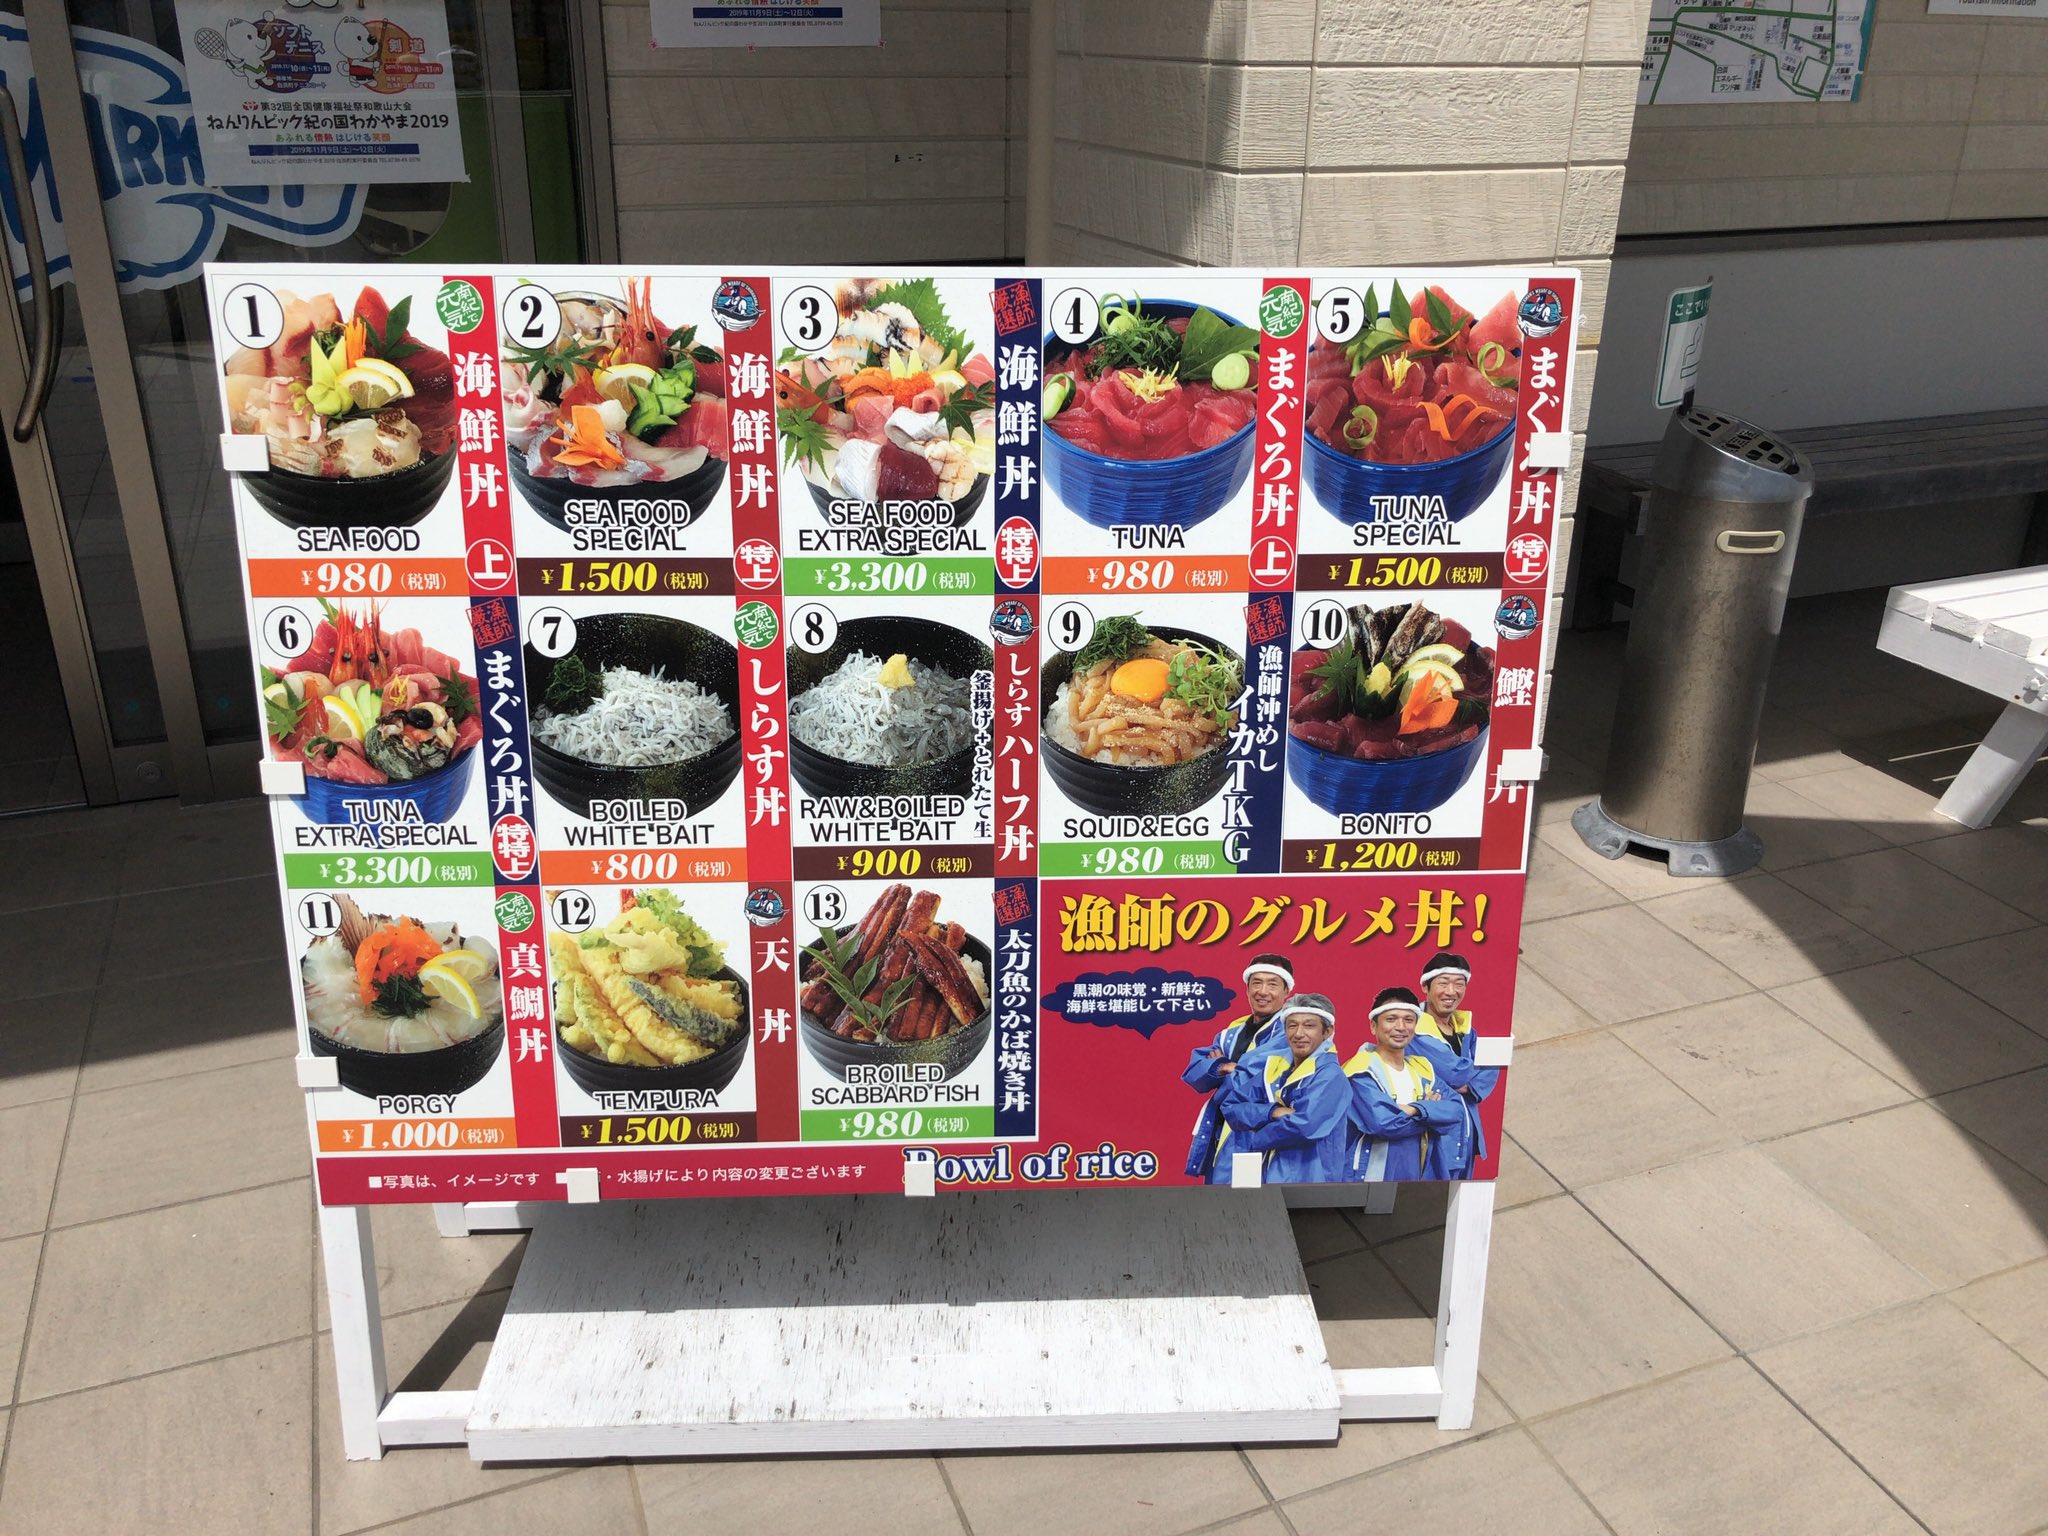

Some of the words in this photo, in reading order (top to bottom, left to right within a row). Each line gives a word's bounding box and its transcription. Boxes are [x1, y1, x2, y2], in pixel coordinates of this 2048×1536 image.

[272, 24, 313, 37] ソフト
[285, 38, 326, 55] テニス
[261, 101, 412, 112] 第32回全国健康福祉祭和歌山大会
[207, 114, 449, 130] ねんりんピック紀の国わかやま2019
[242, 295, 265, 338] 1
[520, 296, 545, 338] 2
[799, 297, 822, 340] 3
[1065, 297, 1084, 335] 4
[1329, 297, 1352, 334] 5
[453, 352, 504, 508] 海鮮丼
[729, 353, 774, 509] 海鮮丼
[998, 345, 1038, 500] 海鮮丼
[1256, 348, 1299, 528] まぐろ丼
[565, 503, 618, 525] SEA
[622, 503, 690, 525] FOOD
[831, 503, 881, 526] SEA
[886, 503, 954, 525] FOOD
[1371, 498, 1446, 521] TUNA
[297, 529, 348, 552] SEA
[353, 529, 420, 551] FOOD
[573, 529, 686, 551] SPECIAL
[799, 529, 882, 551] EXTRA
[888, 529, 987, 551] SPECIAL
[1112, 527, 1185, 549] TUNA
[1353, 524, 1461, 546] SPECIAL
[473, 544, 508, 580] 上
[739, 545, 774, 583] 特上
[1000, 526, 1034, 583] 特特上
[1255, 542, 1287, 577] 上
[1511, 539, 1546, 576] 特上
[301, 563, 392, 592] ¥980
[401, 572, 446, 590] (税別)
[541, 562, 658, 592] ¥1,500
[663, 572, 709, 590] (税別)
[815, 562, 927, 592] ¥3,300
[932, 571, 976, 590] (税別)
[1087, 560, 1174, 590] ¥980
[1185, 568, 1229, 587] (税別)
[1328, 557, 1441, 587] ¥1,500
[1445, 565, 1489, 584] (税別)
[278, 615, 299, 650] 6
[542, 616, 562, 650] 7
[805, 612, 824, 646] 8
[1062, 610, 1081, 644] 9
[1309, 608, 1342, 641] 10
[1256, 645, 1283, 772] 漁師沖めし
[484, 650, 530, 816] まぐろ丼
[747, 658, 787, 827] しらす丼
[998, 652, 1035, 862] しらすハーフ丼
[1222, 685, 1257, 863] イカTKG
[344, 801, 421, 822] TUNA
[592, 802, 686, 822] BOILED
[801, 798, 965, 819] RAW&BOILED
[295, 826, 375, 847] EXTRA
[379, 824, 477, 846] SPECIAL
[564, 826, 648, 846] WHITE
[655, 825, 715, 845] BAIT
[810, 822, 893, 842] WHITE
[899, 821, 957, 841] BAIT
[1063, 817, 1209, 838] SQUID&EGG
[1341, 815, 1431, 835] BONITO
[497, 823, 533, 876] 特特上
[837, 849, 921, 876] ¥900
[930, 856, 973, 872] (税別)
[1080, 847, 1163, 873] ¥980
[1173, 853, 1216, 870] (税別)
[1305, 842, 1417, 872] ¥1,200
[1419, 850, 1462, 866] (税別)
[320, 856, 432, 884] ¥3,300
[434, 864, 478, 882] (税別)
[591, 853, 678, 880] ¥800
[688, 860, 732, 877] (税別)
[303, 900, 336, 929] 11
[557, 897, 591, 926] 12
[811, 892, 841, 921] 13
[1060, 888, 1489, 954] 漁師のグルメ丼!
[506, 943, 549, 1063] 真鯛丼
[755, 937, 792, 1044] 天丼
[1072, 982, 1206, 997] 黒潮の味覚・新鮮な
[1066, 998, 1212, 1014] 海鮮を堪能して下さい
[998, 929, 1033, 1113] 太刀魚のかば焼き丼
[848, 1065, 944, 1084] BROILED
[379, 1096, 458, 1114] PORGY
[595, 1089, 719, 1111] TEMPURA
[811, 1085, 928, 1105] SCABBARD
[935, 1084, 979, 1102] FISH
[342, 1121, 458, 1149] ¥1,000
[460, 1127, 505, 1145] (税別)
[581, 1116, 691, 1144] ¥1,500
[696, 1122, 740, 1139] (税別)
[839, 1111, 923, 1138] ¥980
[927, 1117, 969, 1133] (税別)
[598, 1163, 867, 1186] ・水揚げにより内容の変更ございます
[1022, 1145, 1071, 1180] of
[1076, 1144, 1156, 1179] rice
